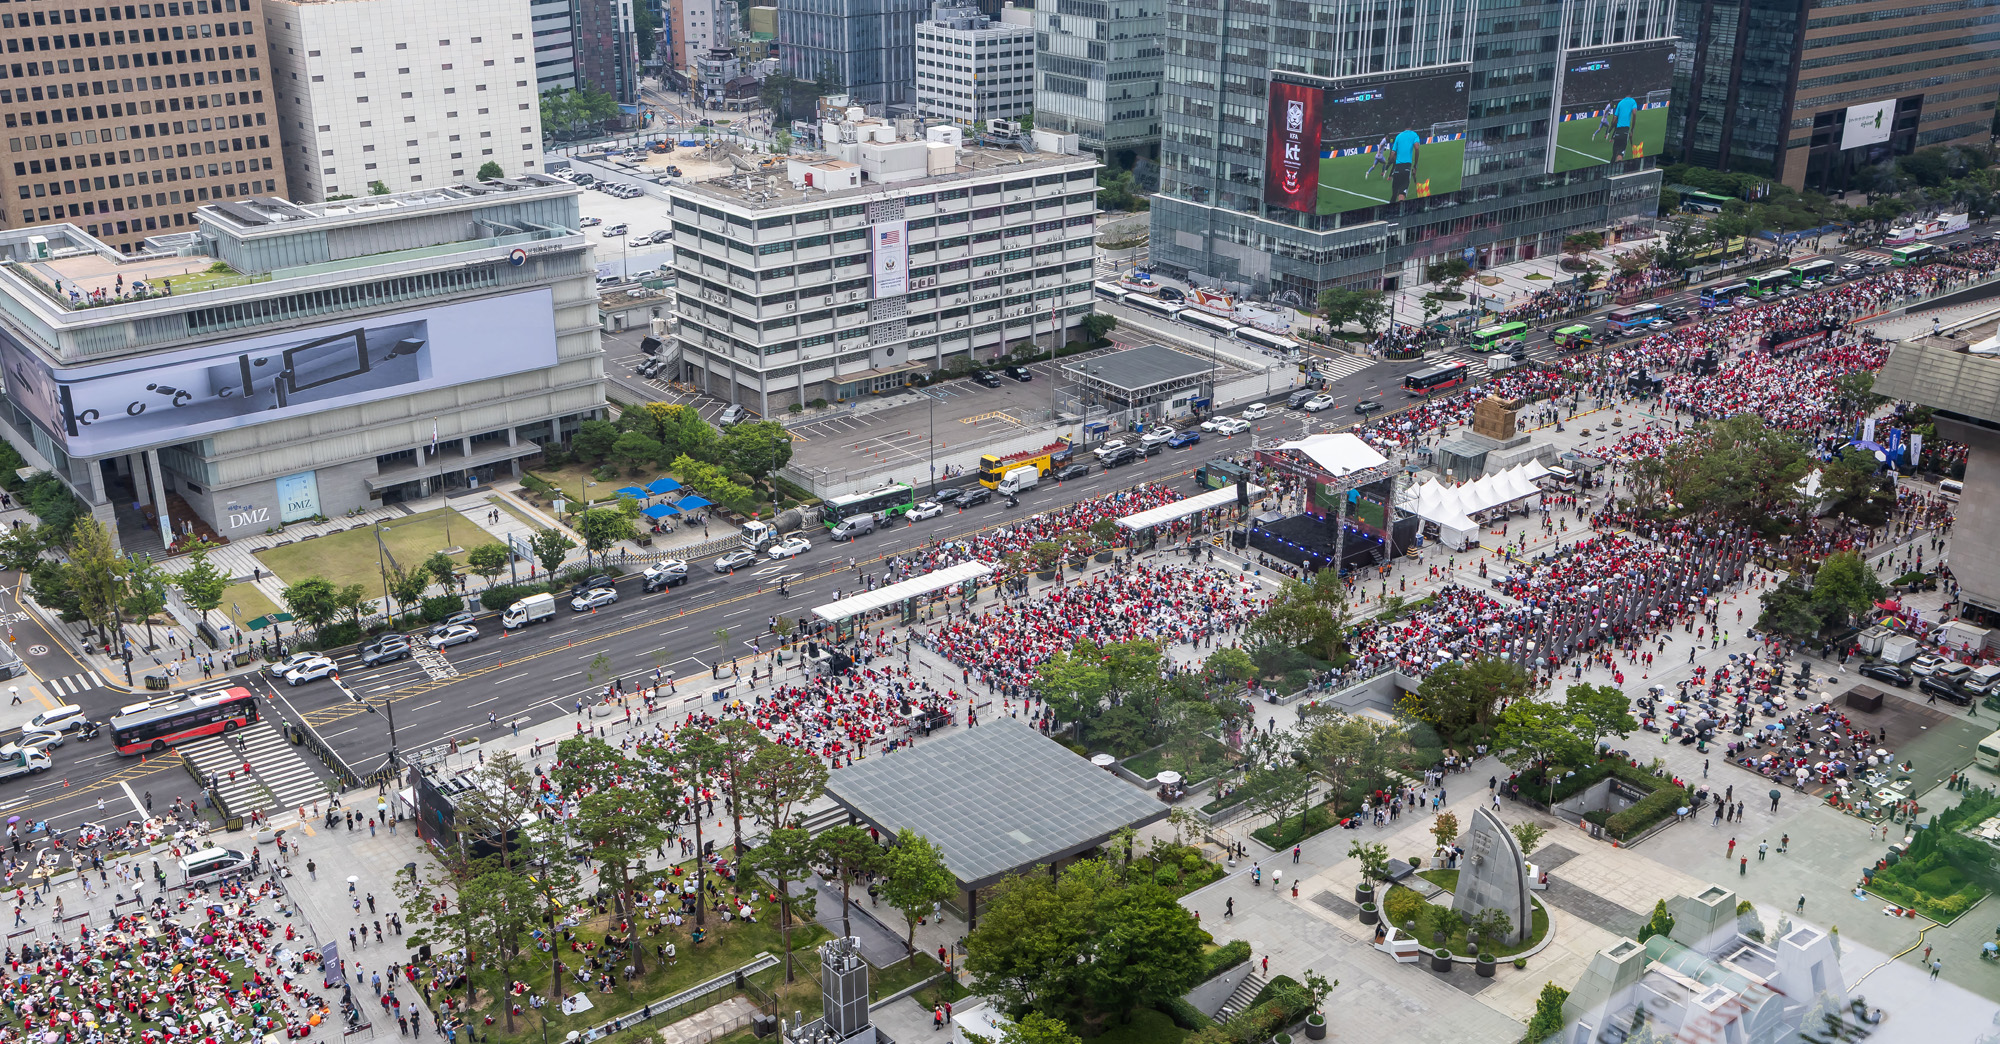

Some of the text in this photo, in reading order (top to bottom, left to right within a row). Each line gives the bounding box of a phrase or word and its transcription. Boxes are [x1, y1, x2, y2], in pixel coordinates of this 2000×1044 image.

[1575, 112, 1588, 121] VISA
[1437, 134, 1450, 143] VISA
[1285, 142, 1301, 161] kt
[1343, 147, 1359, 157] VISA
[288, 499, 312, 512] DMZ
[228, 507, 270, 529] DMZ
[30, 645, 47, 655] 30
